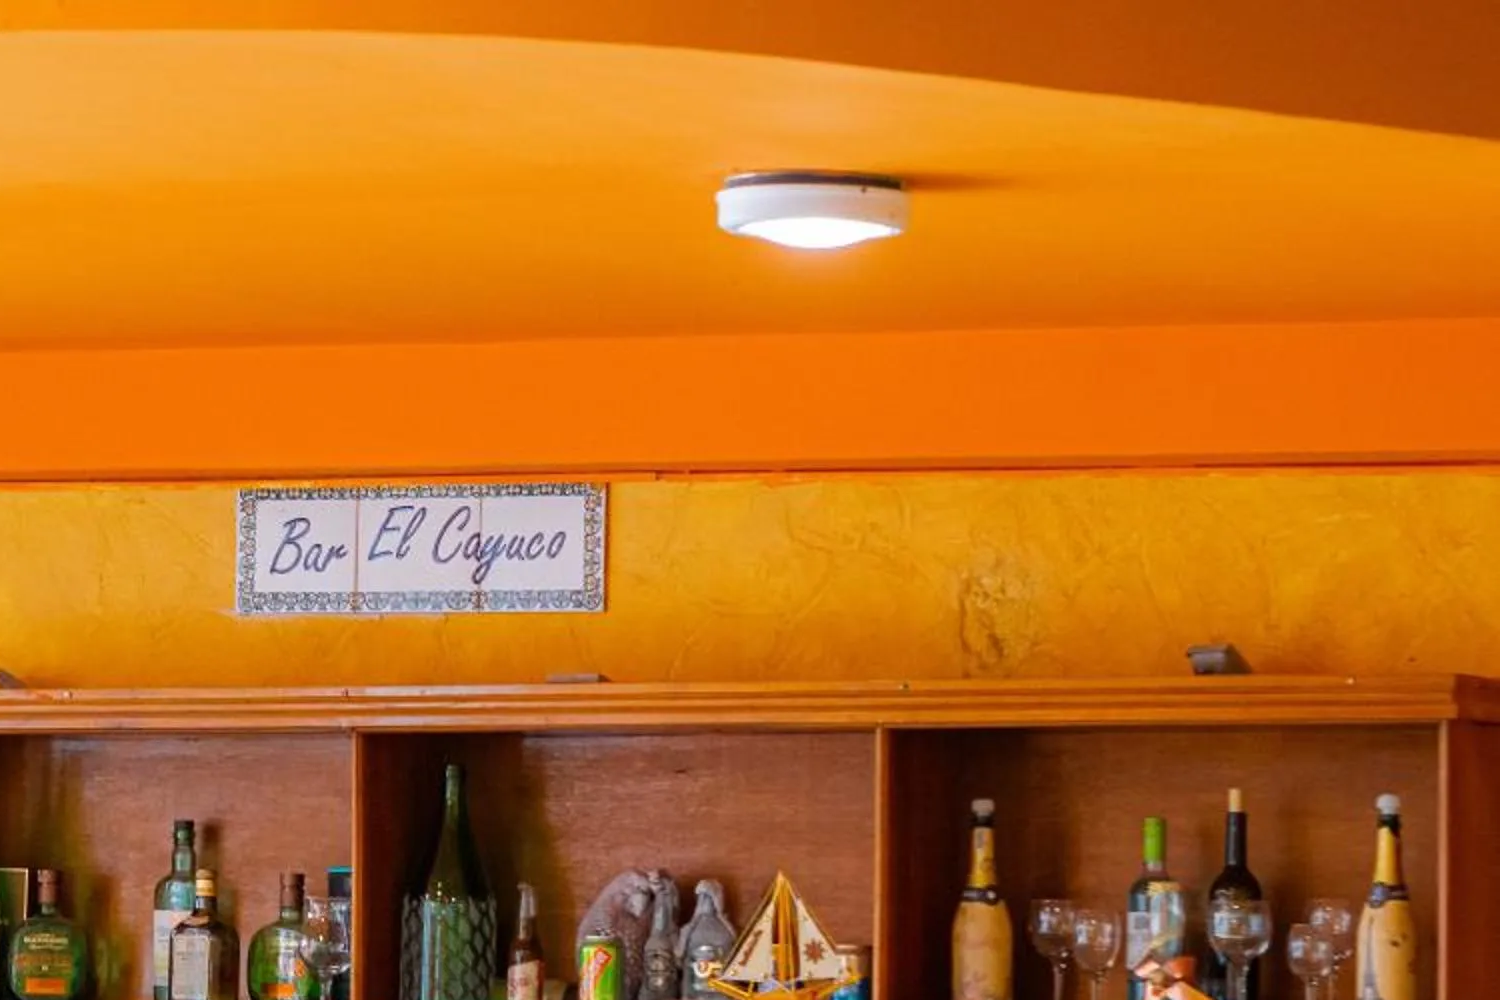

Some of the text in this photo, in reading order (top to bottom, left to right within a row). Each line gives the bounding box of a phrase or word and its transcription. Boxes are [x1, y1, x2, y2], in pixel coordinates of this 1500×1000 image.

[270, 505, 567, 585] Bar El Cayuco
